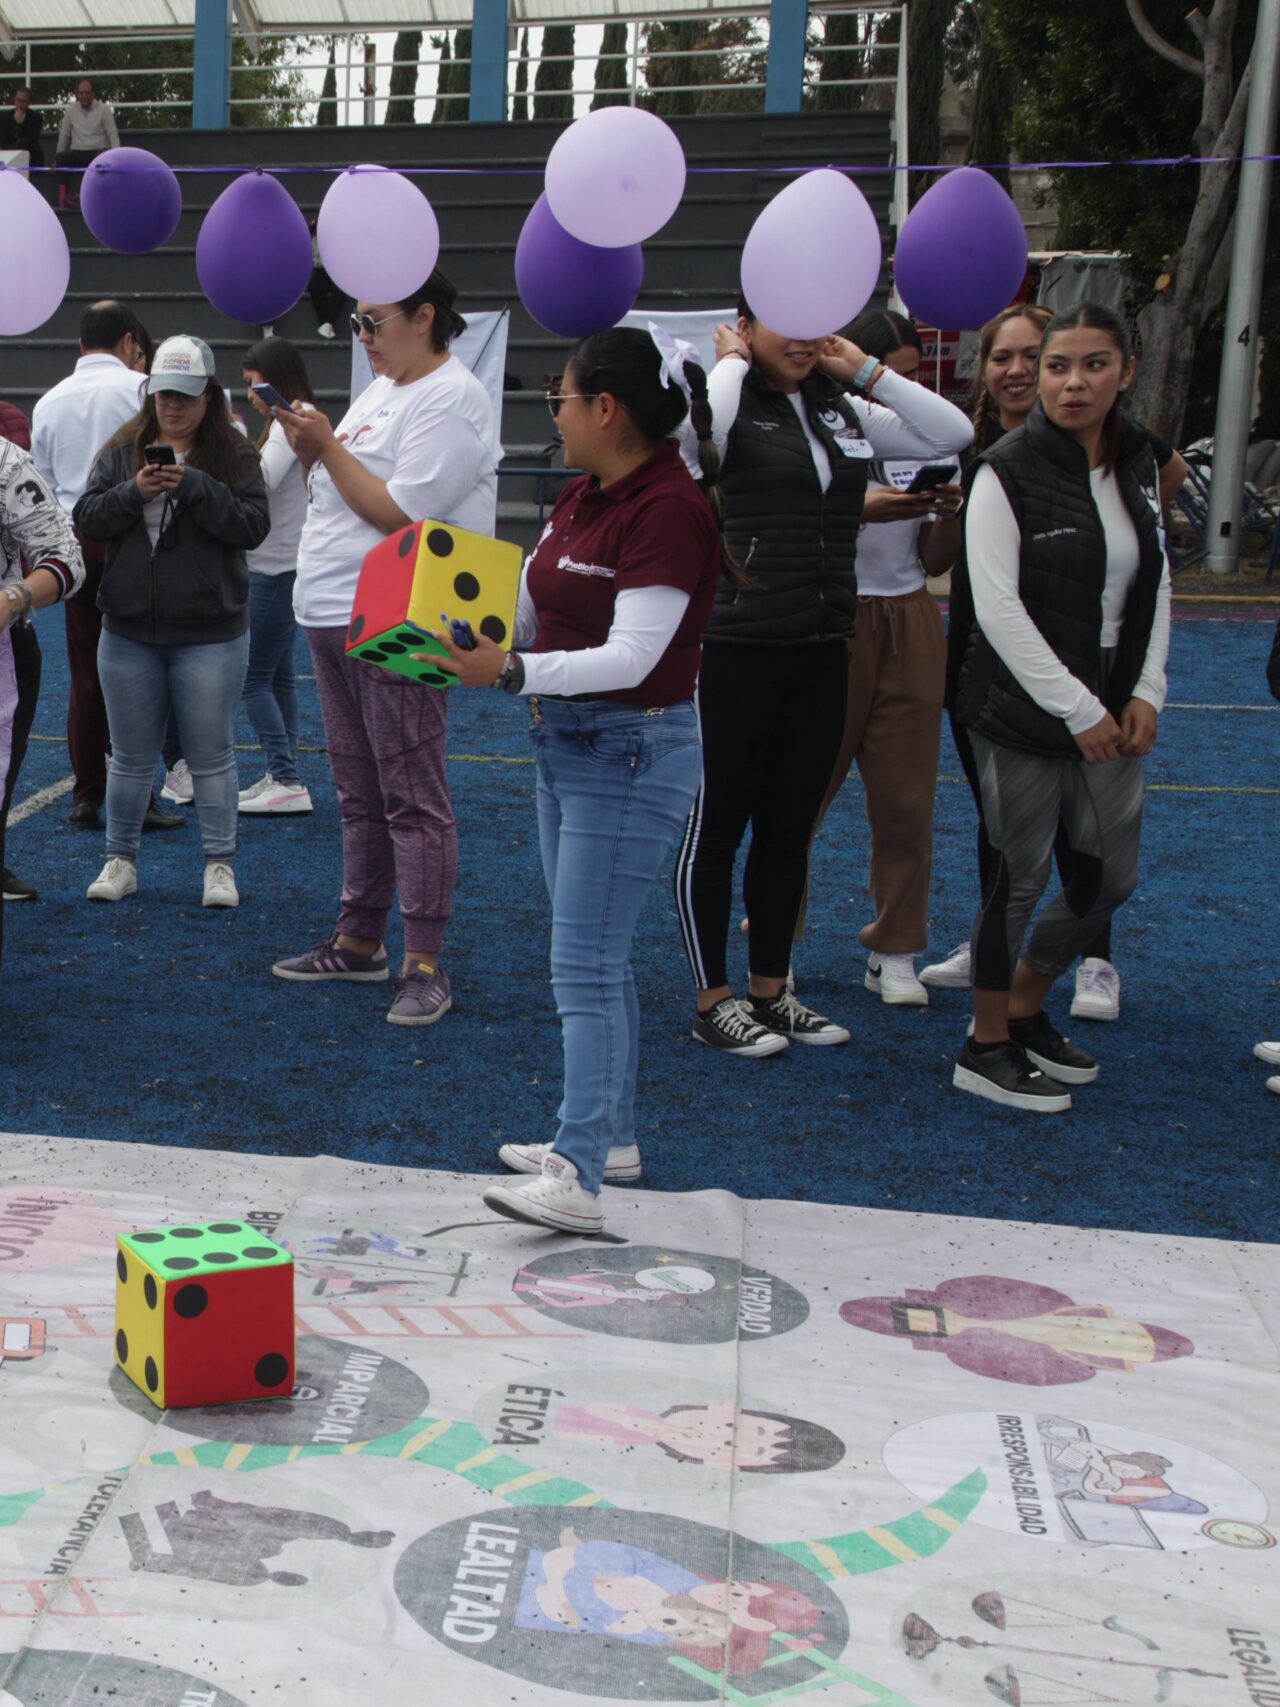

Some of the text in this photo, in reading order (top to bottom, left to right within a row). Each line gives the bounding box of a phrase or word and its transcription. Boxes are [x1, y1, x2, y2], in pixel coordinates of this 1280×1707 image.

[1237, 324, 1250, 347] 4
[740, 1276, 773, 1334] VERDAD
[312, 1352, 384, 1443] IMPARCIAL
[492, 1384, 567, 1445] ÉTICA
[442, 1521, 520, 1643] LEALTAD
